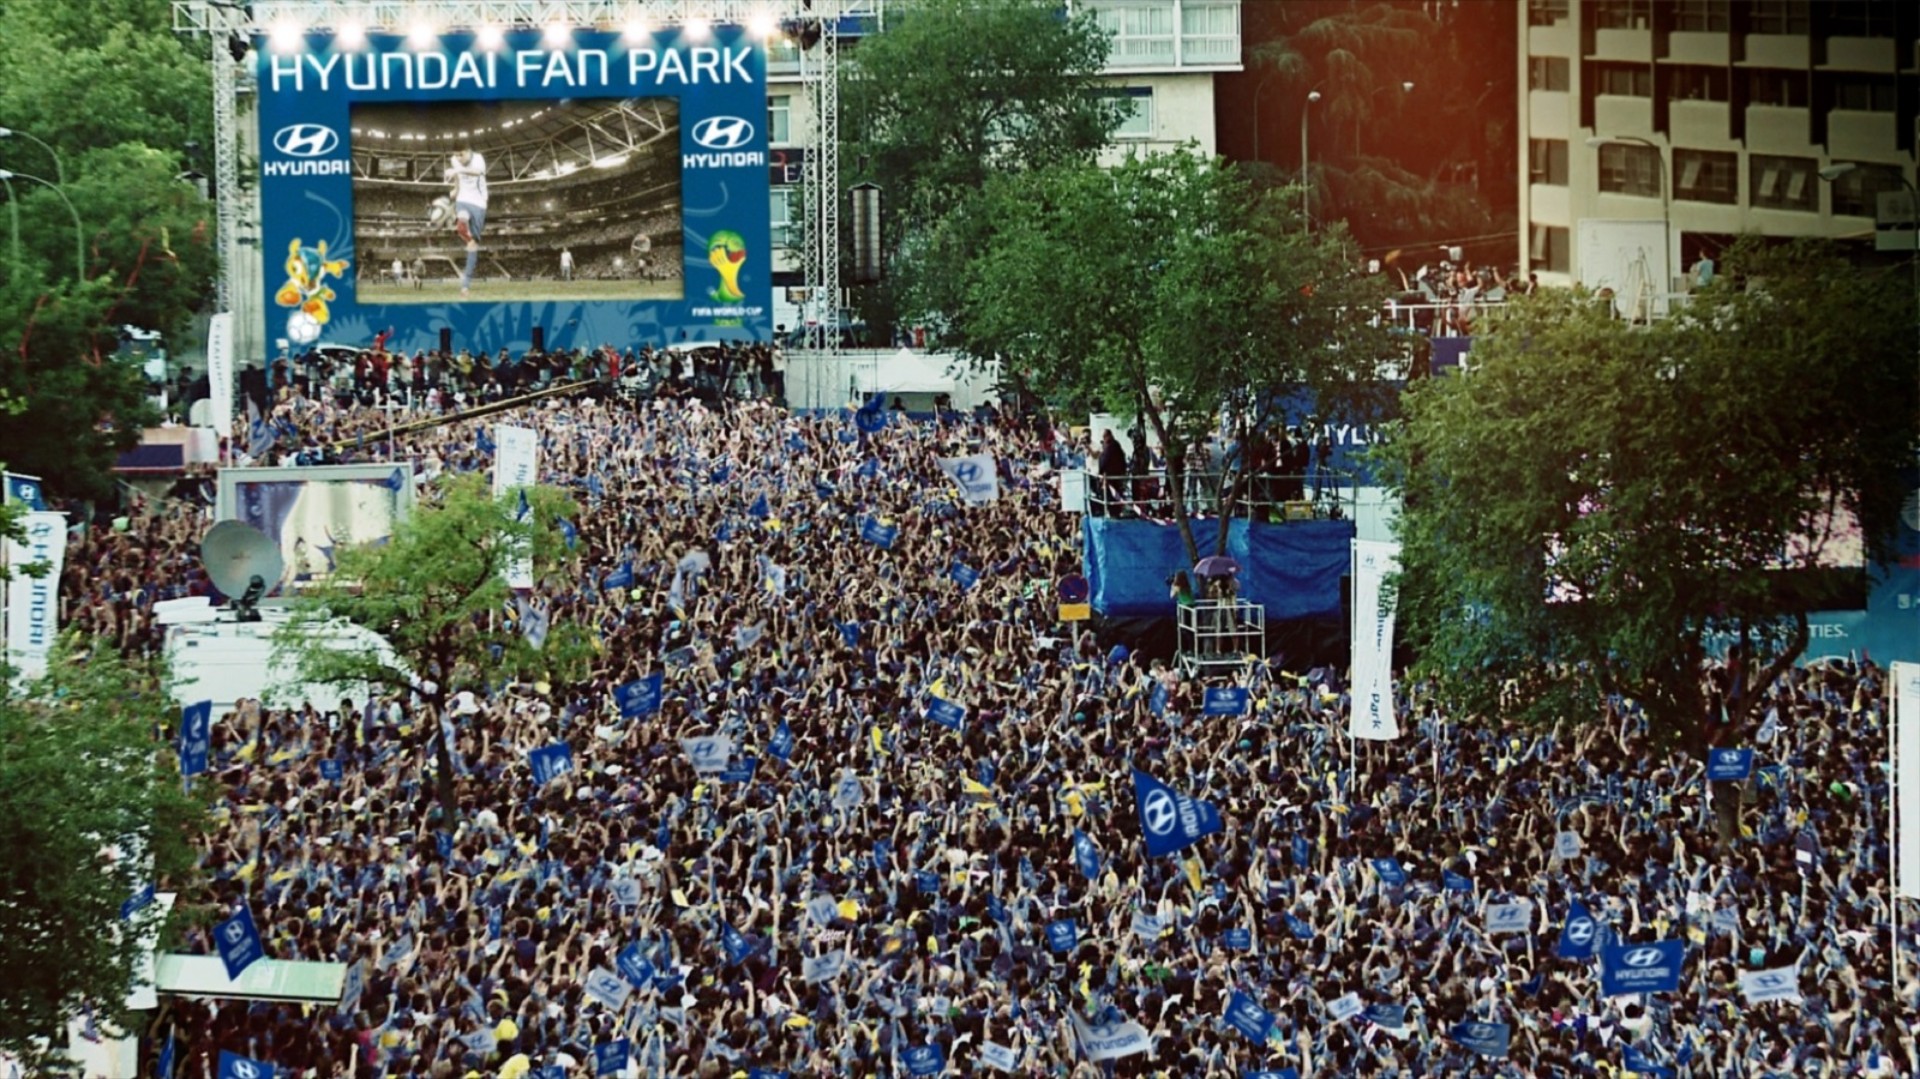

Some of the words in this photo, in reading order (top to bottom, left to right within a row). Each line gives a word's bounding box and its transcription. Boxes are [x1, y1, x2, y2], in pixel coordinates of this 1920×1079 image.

[270, 51, 497, 92] HYUNDAI
[515, 48, 608, 88] FAN
[628, 46, 754, 86] PARK
[263, 159, 351, 176] HYUNDAI
[683, 151, 764, 169] HYUNDAI
[29, 543, 49, 645] HUNDAI
[1370, 693, 1382, 730] Park
[1615, 967, 1670, 980] HYUNDAI
